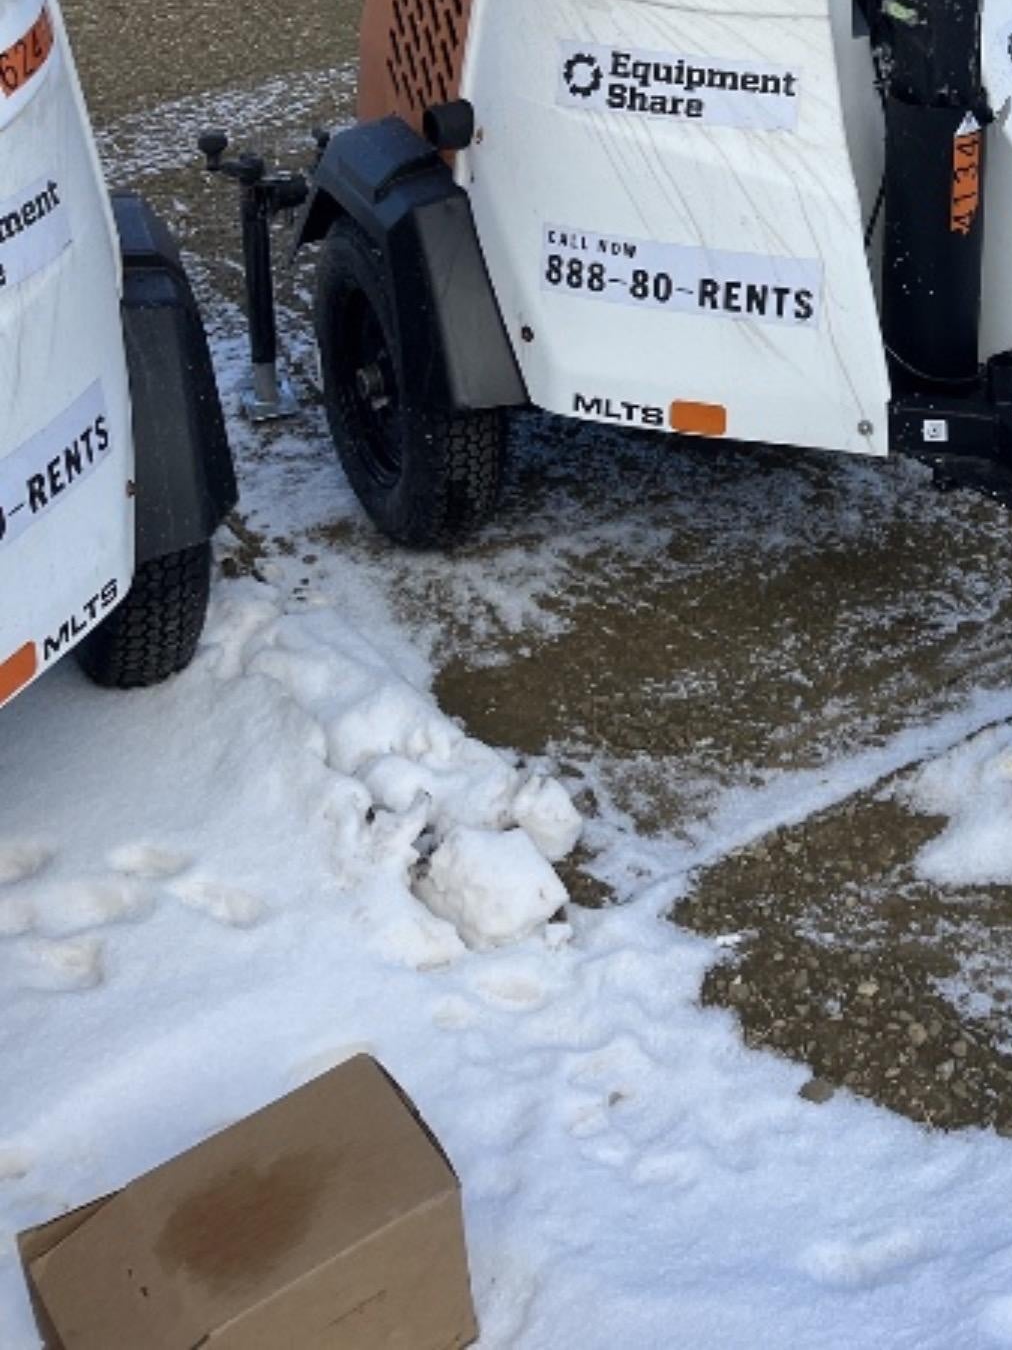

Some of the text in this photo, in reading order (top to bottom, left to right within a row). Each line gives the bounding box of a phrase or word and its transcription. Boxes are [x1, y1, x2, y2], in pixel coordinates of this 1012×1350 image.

[609, 51, 796, 96] Equipment
[607, 83, 704, 117] Share
[548, 230, 637, 258] CALL NOW
[546, 254, 814, 319] 888-80-RENTS
[573, 394, 664, 435] MLTS
[0, 413, 109, 540] -RENTS
[43, 577, 118, 661] MLTS
